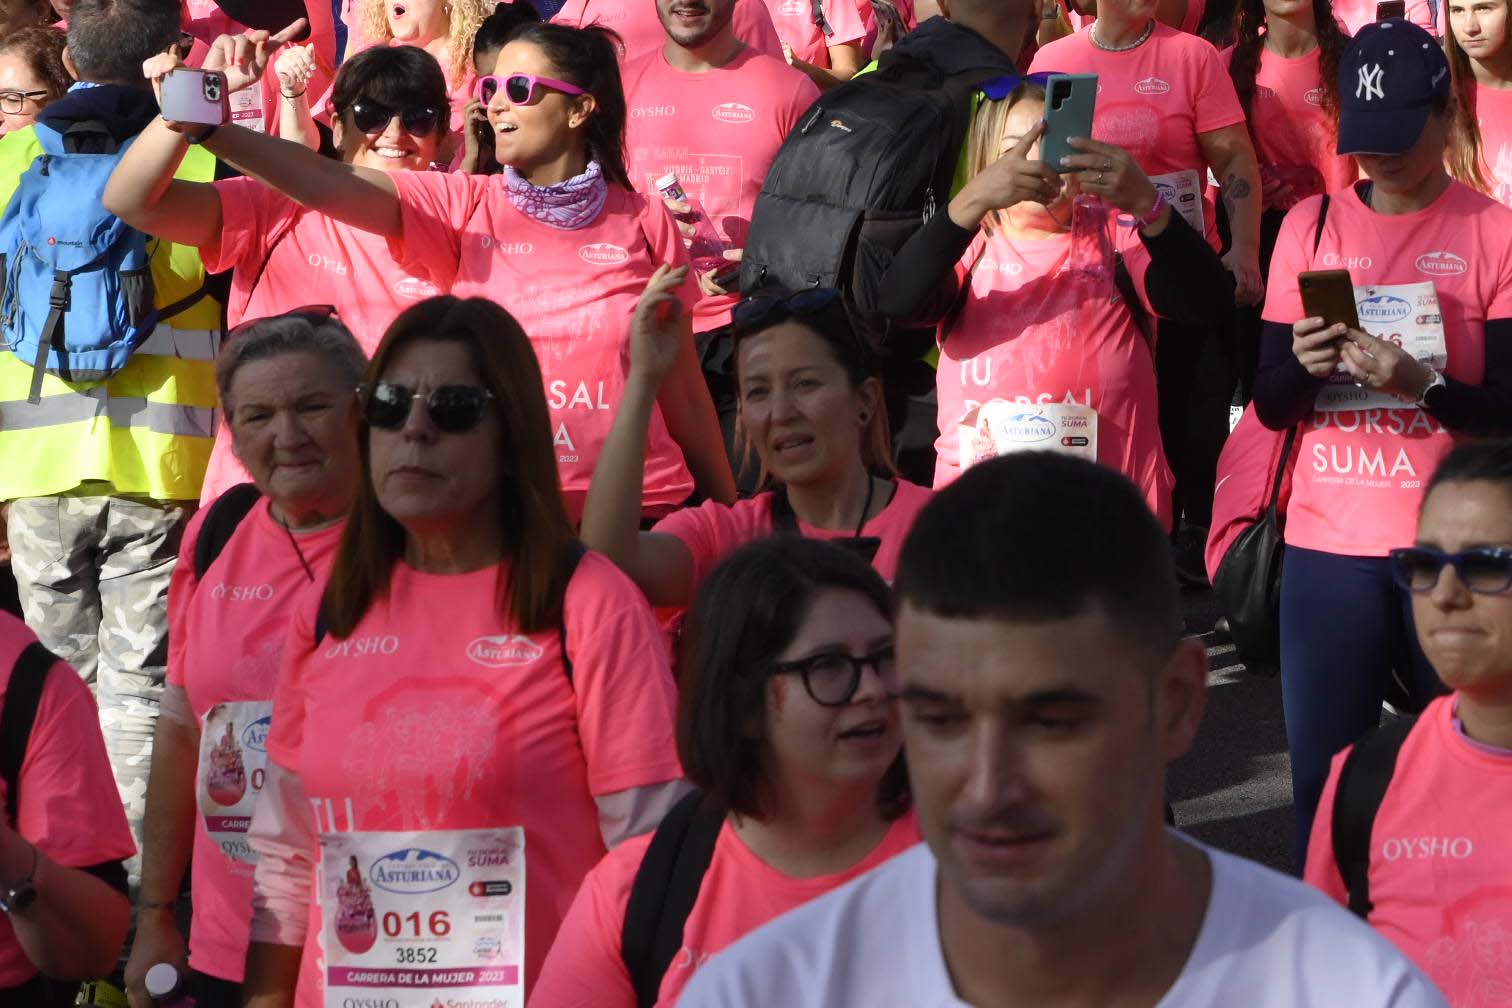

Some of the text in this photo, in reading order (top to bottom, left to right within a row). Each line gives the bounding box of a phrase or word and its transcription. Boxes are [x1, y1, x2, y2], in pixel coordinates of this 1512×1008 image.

[1355, 63, 1385, 101] NY
[629, 105, 676, 119] OYSHO
[1418, 260, 1466, 273] ASTURIANA
[1358, 304, 1408, 317] ASTURIANA
[960, 358, 991, 386] TU
[1061, 420, 1088, 428] SUMA
[1312, 443, 1416, 477] SUMA
[1400, 480, 1421, 489] 2023
[1382, 836, 1473, 861] OYSHO
[468, 857, 510, 867] SUMA
[375, 866, 452, 883] ASTURIANA
[383, 911, 451, 937] 016
[396, 947, 437, 963] 3852
[347, 973, 504, 984] CARRERA DE LA MUJER 2023
